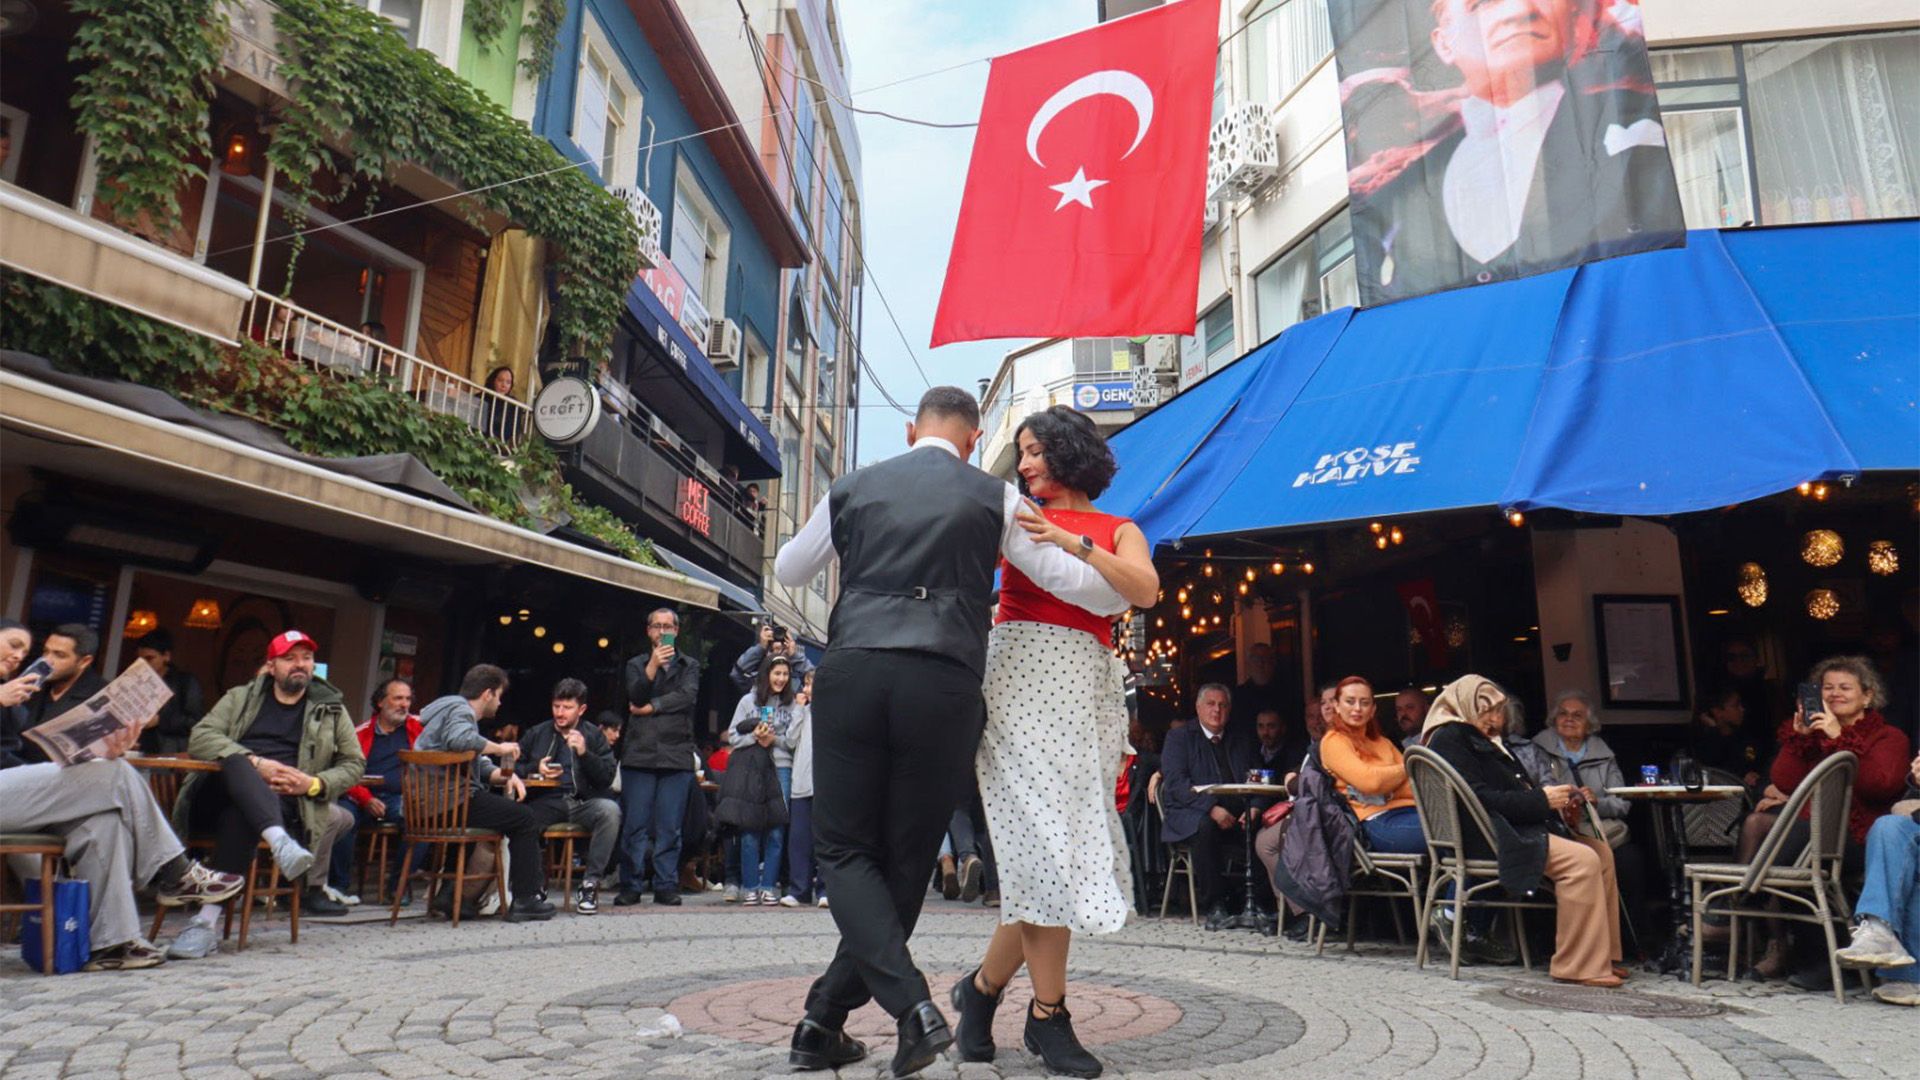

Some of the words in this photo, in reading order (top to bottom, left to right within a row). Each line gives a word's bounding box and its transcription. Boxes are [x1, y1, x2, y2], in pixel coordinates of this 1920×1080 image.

[540, 403, 585, 416] CROFT
[1102, 388, 1134, 403] GENÇ
[1292, 457, 1420, 488] KAHVE
[688, 477, 709, 513] MET
[683, 501, 710, 537] COFFEE
